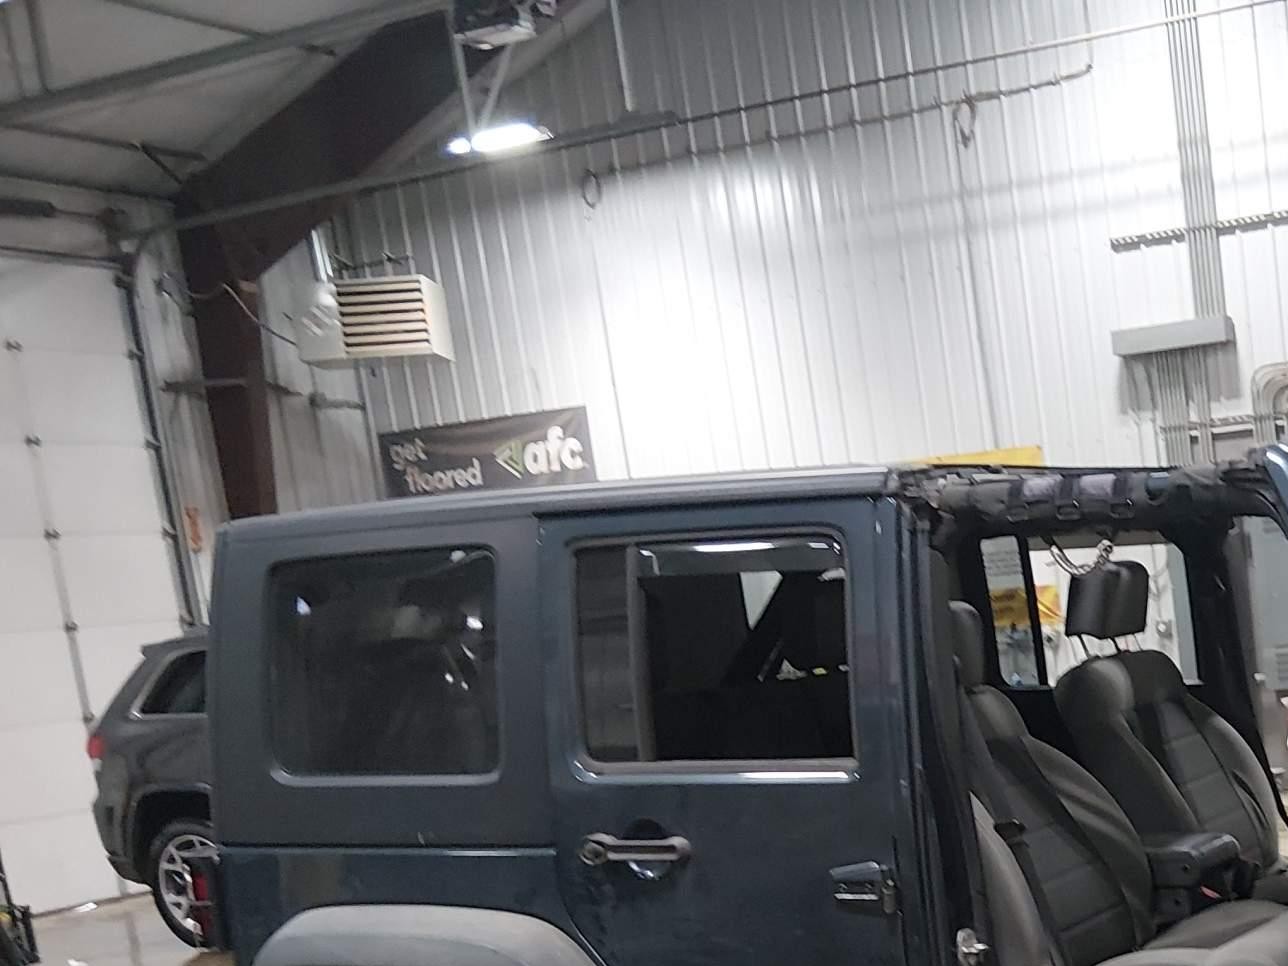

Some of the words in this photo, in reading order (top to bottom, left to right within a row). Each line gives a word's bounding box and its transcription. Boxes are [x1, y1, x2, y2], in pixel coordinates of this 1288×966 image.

[389, 438, 428, 471] get
[523, 425, 584, 475] afc
[404, 457, 484, 495] floored
